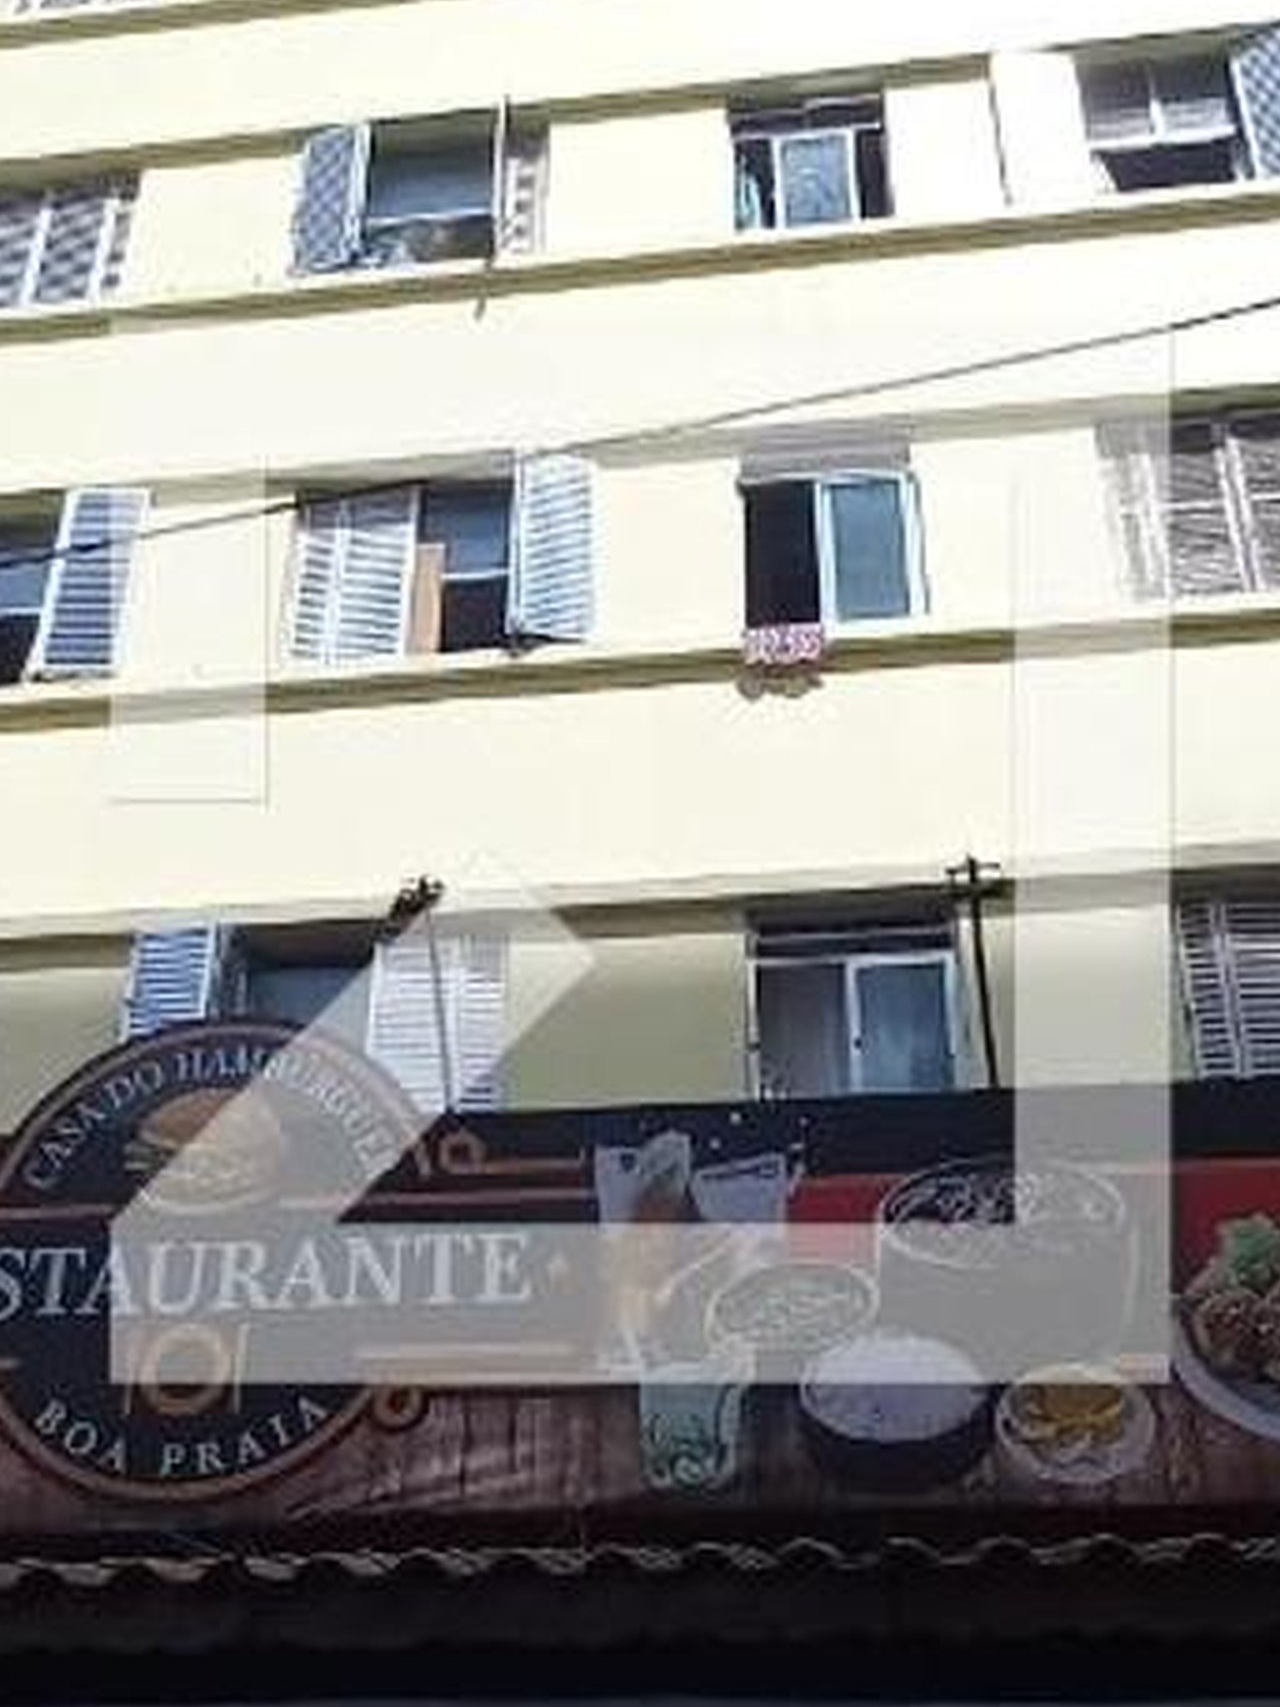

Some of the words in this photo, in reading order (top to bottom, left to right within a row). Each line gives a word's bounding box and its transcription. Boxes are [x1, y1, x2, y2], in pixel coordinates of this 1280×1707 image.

[23, 1101, 108, 1189] CASA
[103, 1062, 162, 1109] DO
[34, 1398, 128, 1475] BOA
[159, 1395, 327, 1476] PRAIA
